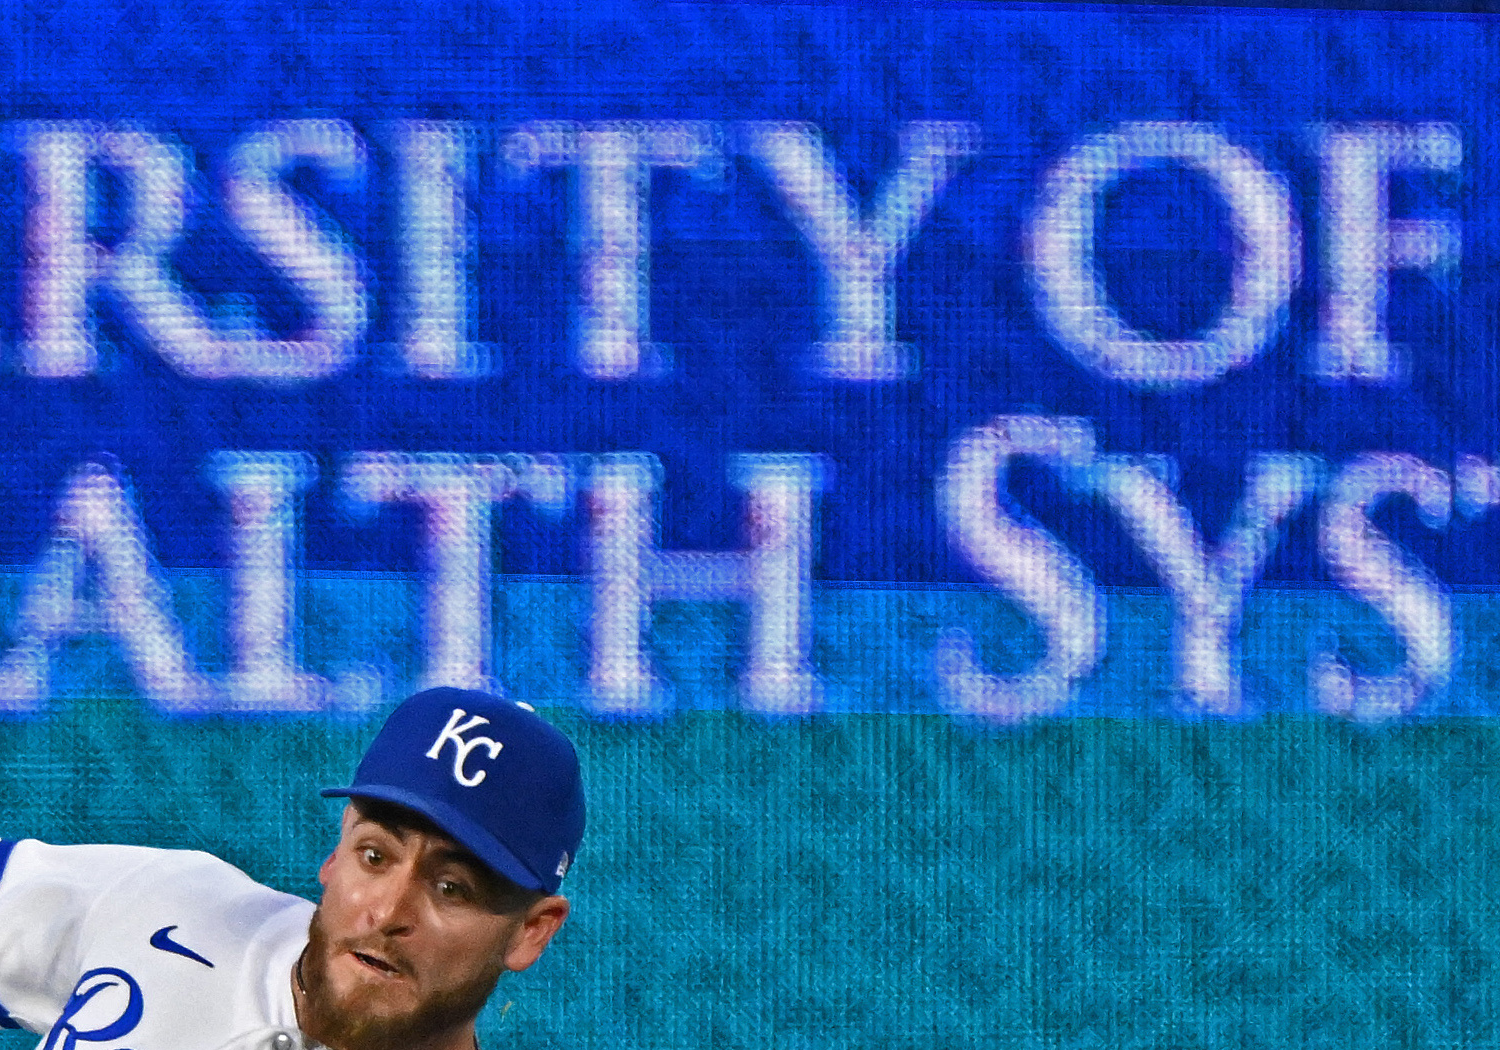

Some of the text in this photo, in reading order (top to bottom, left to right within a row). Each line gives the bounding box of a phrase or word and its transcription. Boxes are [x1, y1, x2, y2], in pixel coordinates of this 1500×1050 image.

[1022, 120, 1466, 387] OF
[934, 413, 1500, 724] SYS
[425, 708, 504, 787] KC
